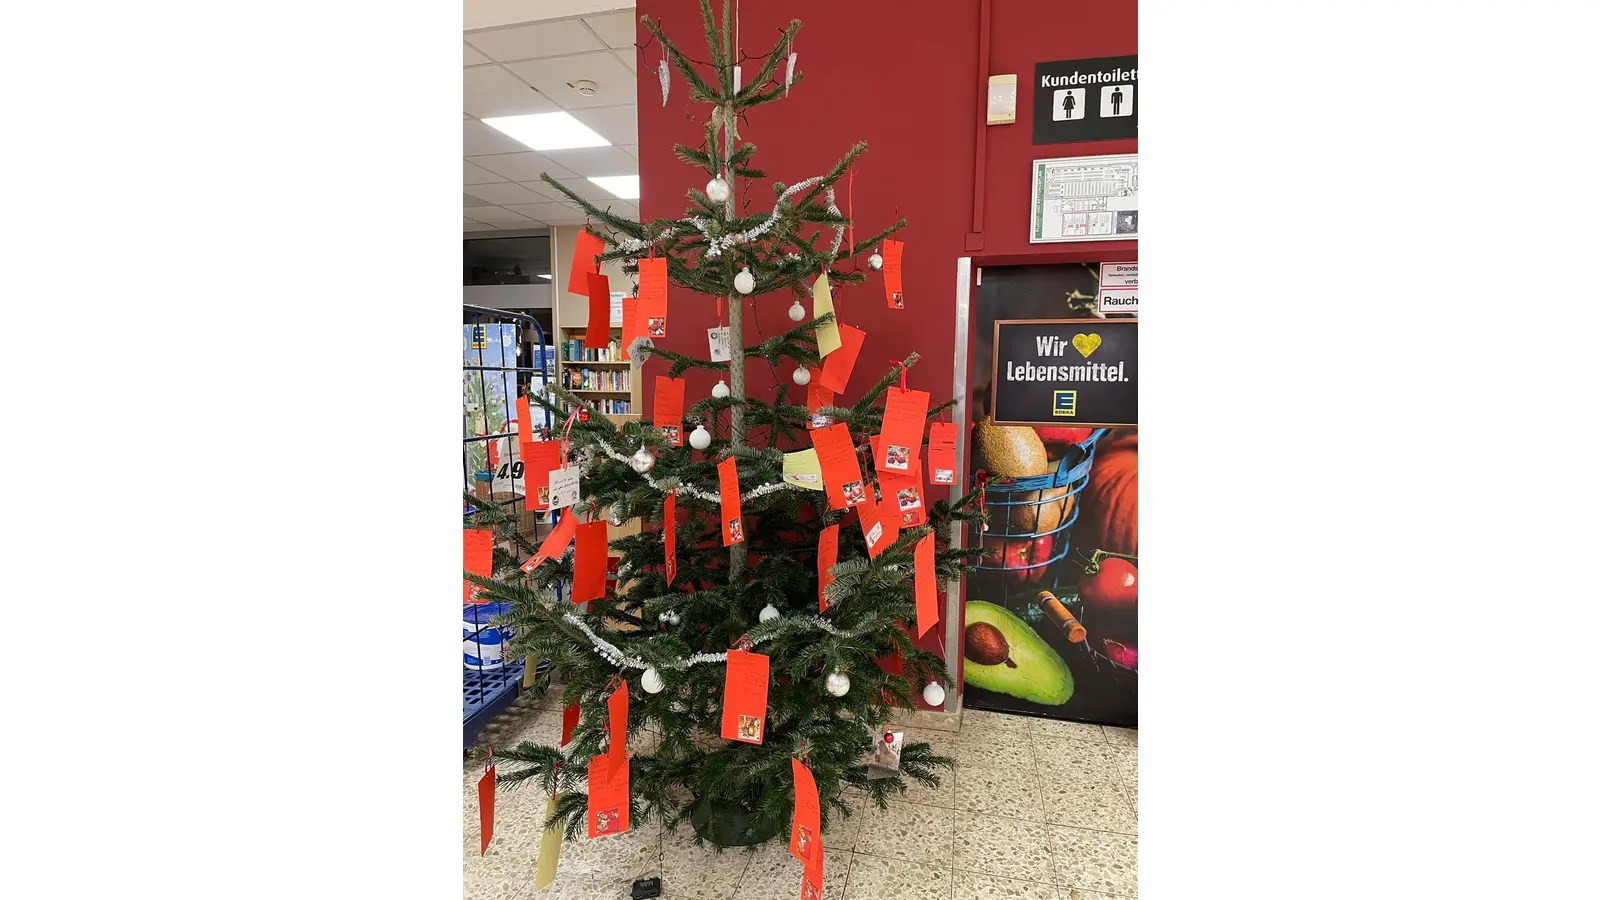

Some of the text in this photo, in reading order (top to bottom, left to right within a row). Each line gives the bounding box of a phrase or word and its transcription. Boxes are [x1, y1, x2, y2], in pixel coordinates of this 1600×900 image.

[1041, 68, 1138, 87] Kundentoilet
[1103, 296, 1138, 306] Rauch
[1036, 335, 1068, 357] Wir
[1006, 361, 1129, 383] Lebensmittel.
